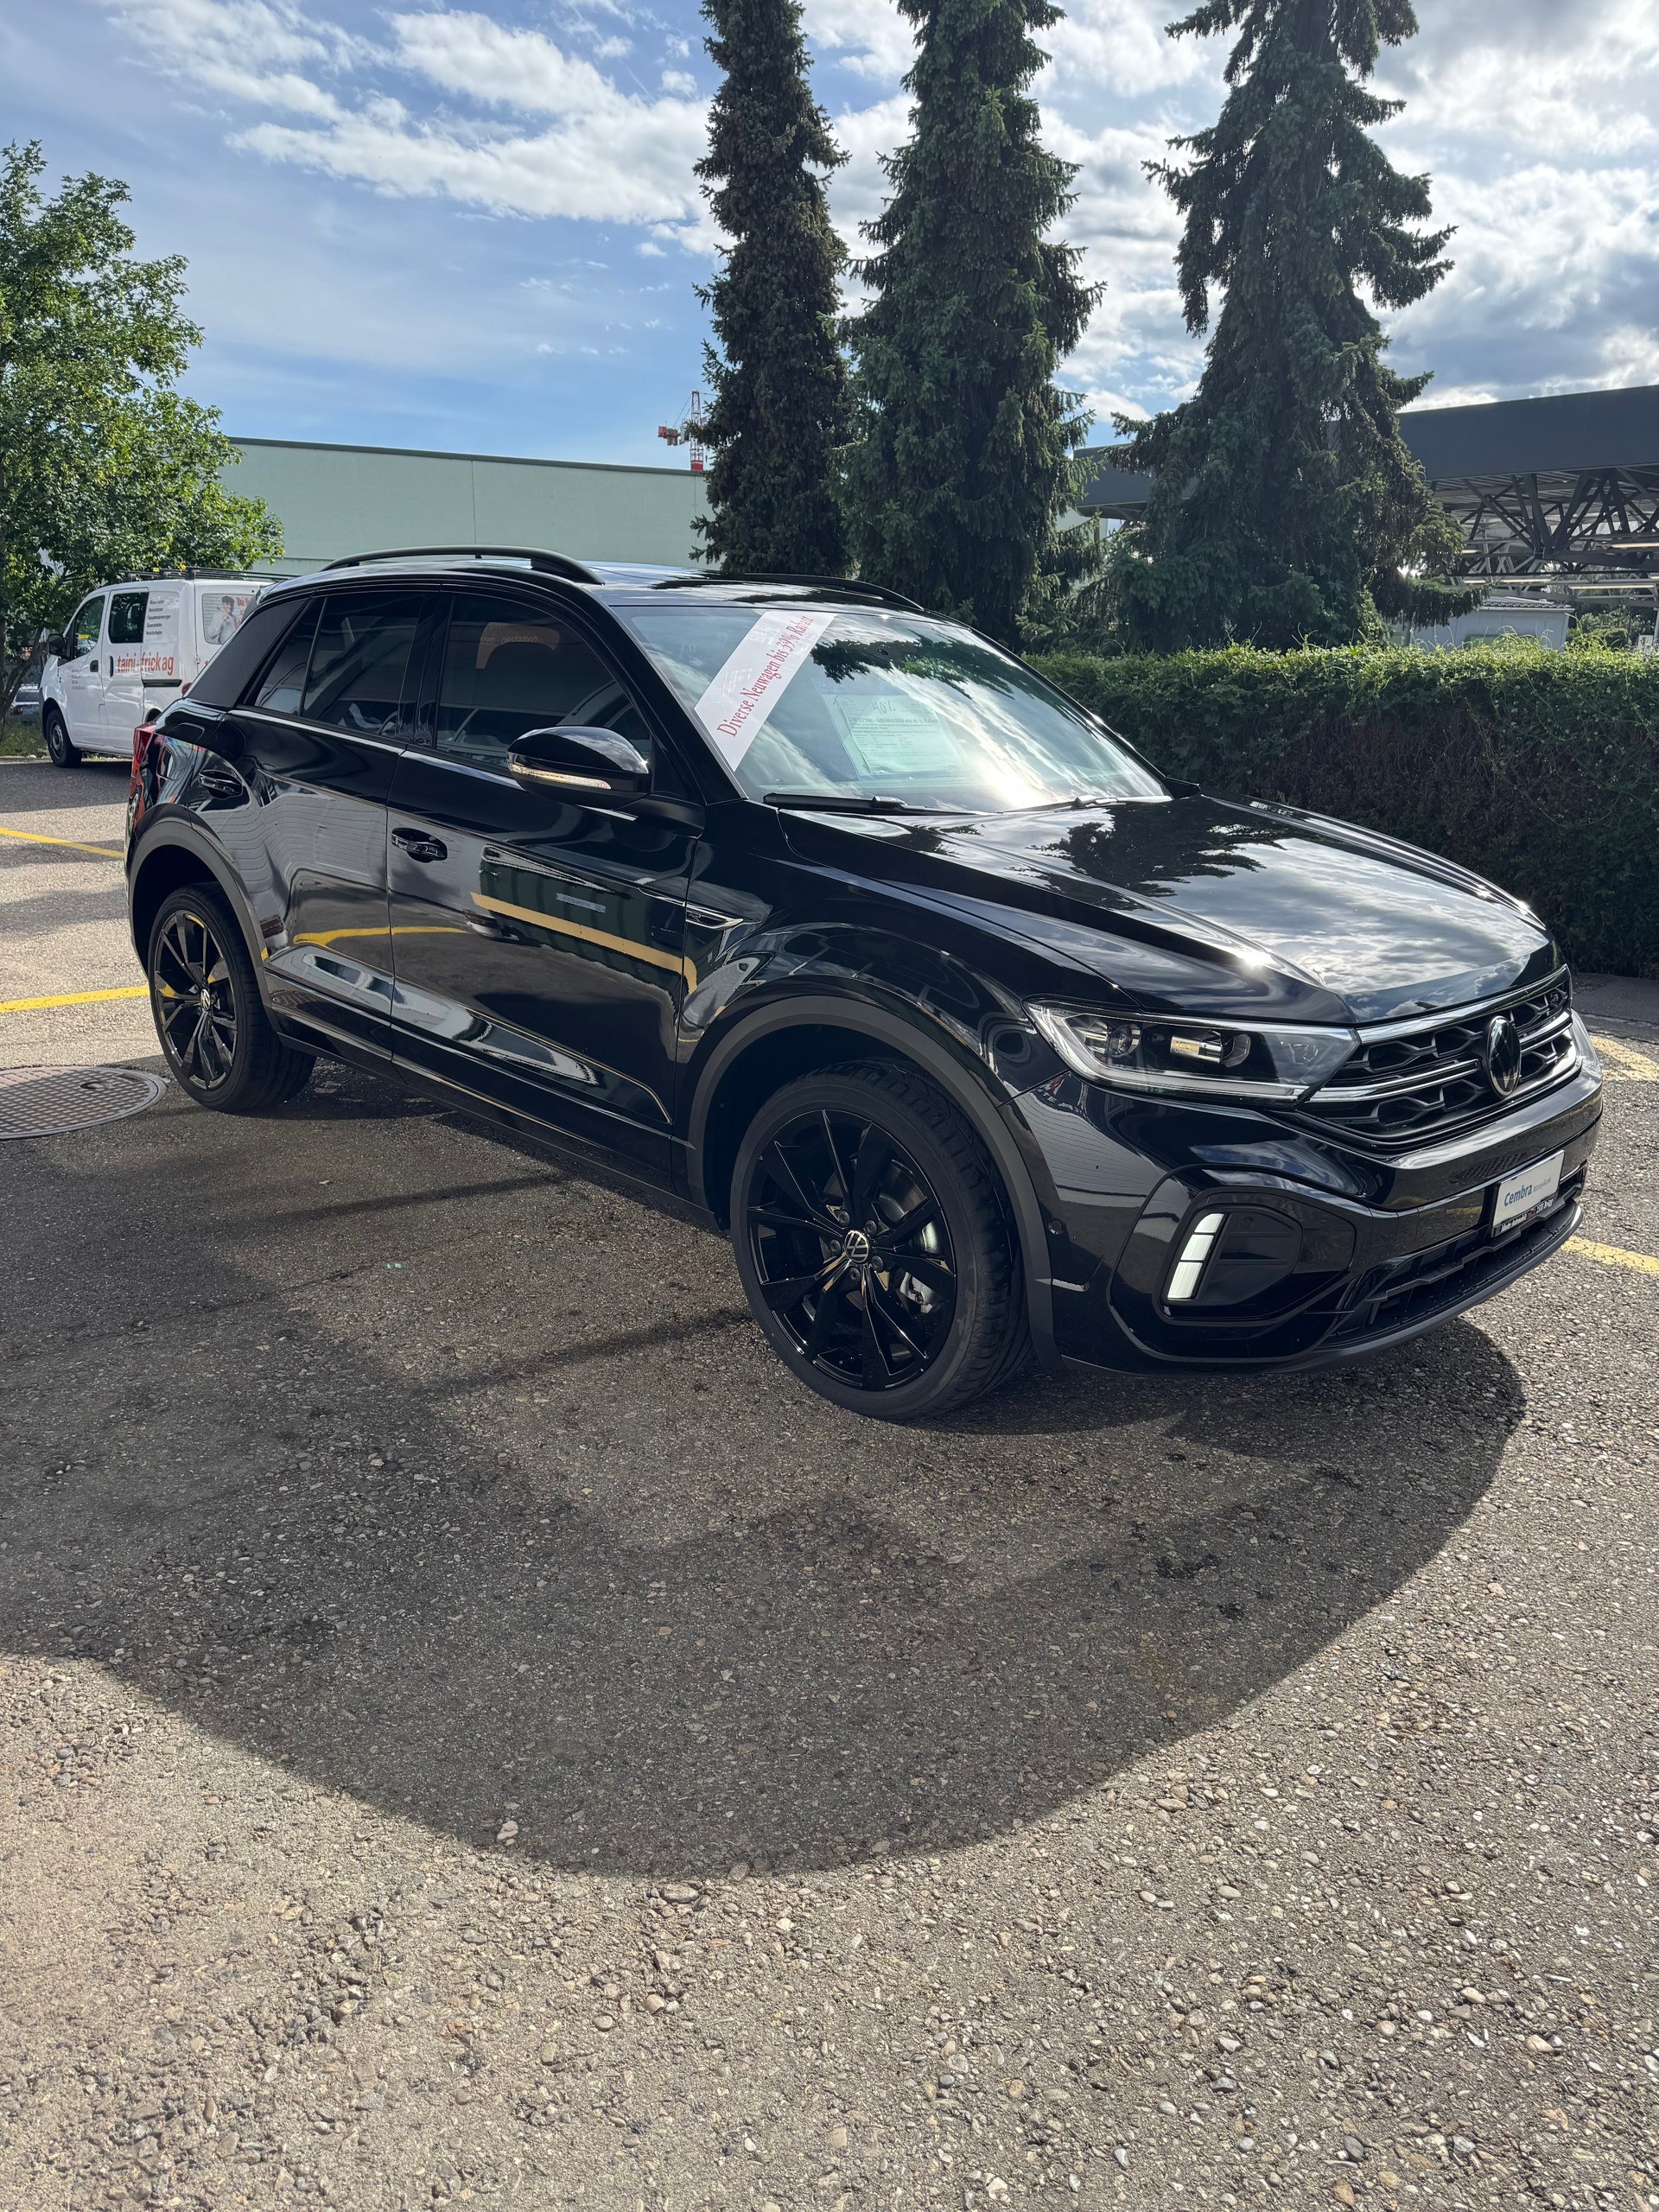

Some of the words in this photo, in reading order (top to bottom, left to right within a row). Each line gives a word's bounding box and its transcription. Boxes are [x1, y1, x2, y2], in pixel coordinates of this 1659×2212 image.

[162, 656, 175, 677] ag
[717, 700, 755, 737] Diverse
[740, 661, 782, 702] Neuwagen
[766, 649, 789, 663] bis
[786, 615, 814, 636] Rabatt
[1504, 1185, 1533, 1207] Cembra
